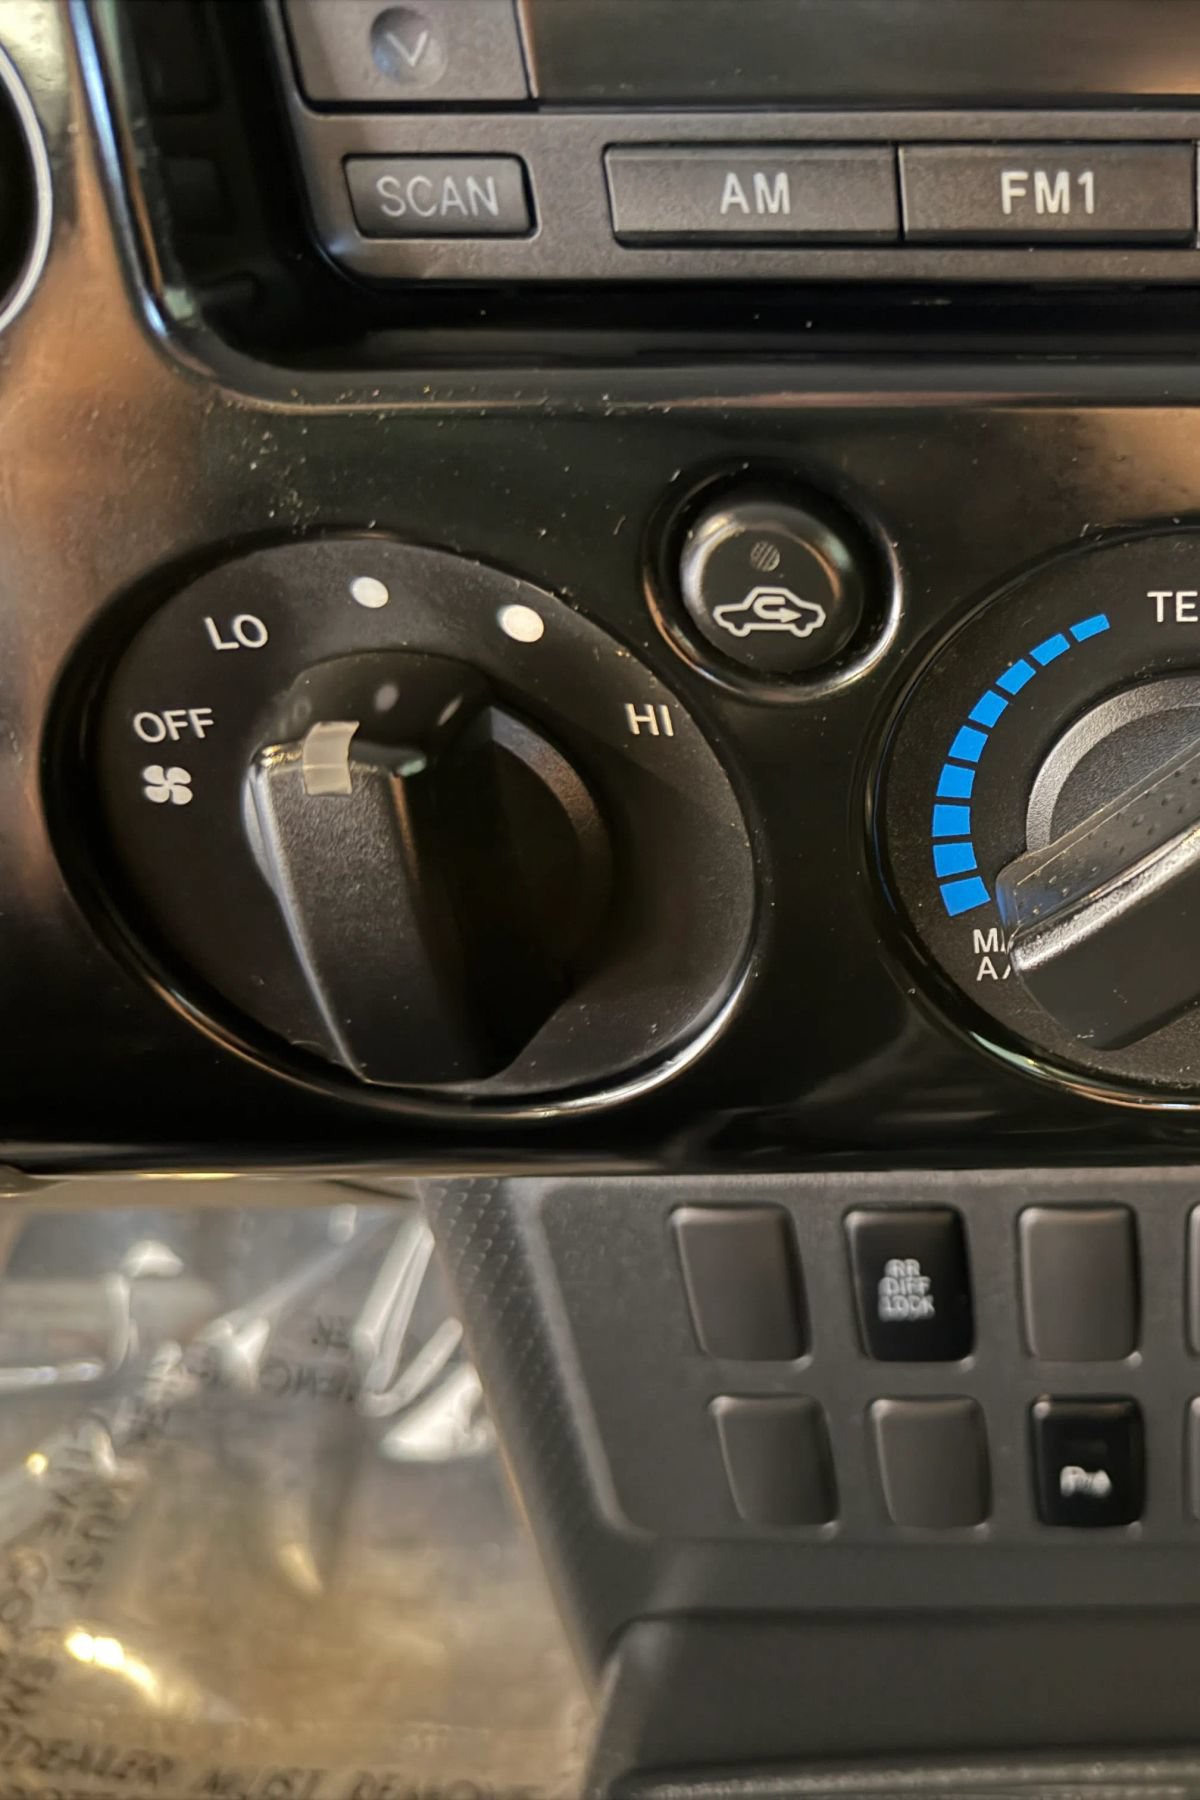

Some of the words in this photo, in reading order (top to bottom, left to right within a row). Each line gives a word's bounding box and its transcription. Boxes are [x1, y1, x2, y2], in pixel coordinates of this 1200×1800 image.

[376, 175, 499, 217] SCAN
[720, 171, 791, 215] AM
[1001, 170, 1094, 214] FM1
[204, 613, 269, 650] LO
[133, 707, 214, 743] OFF
[623, 702, 674, 737] HI
